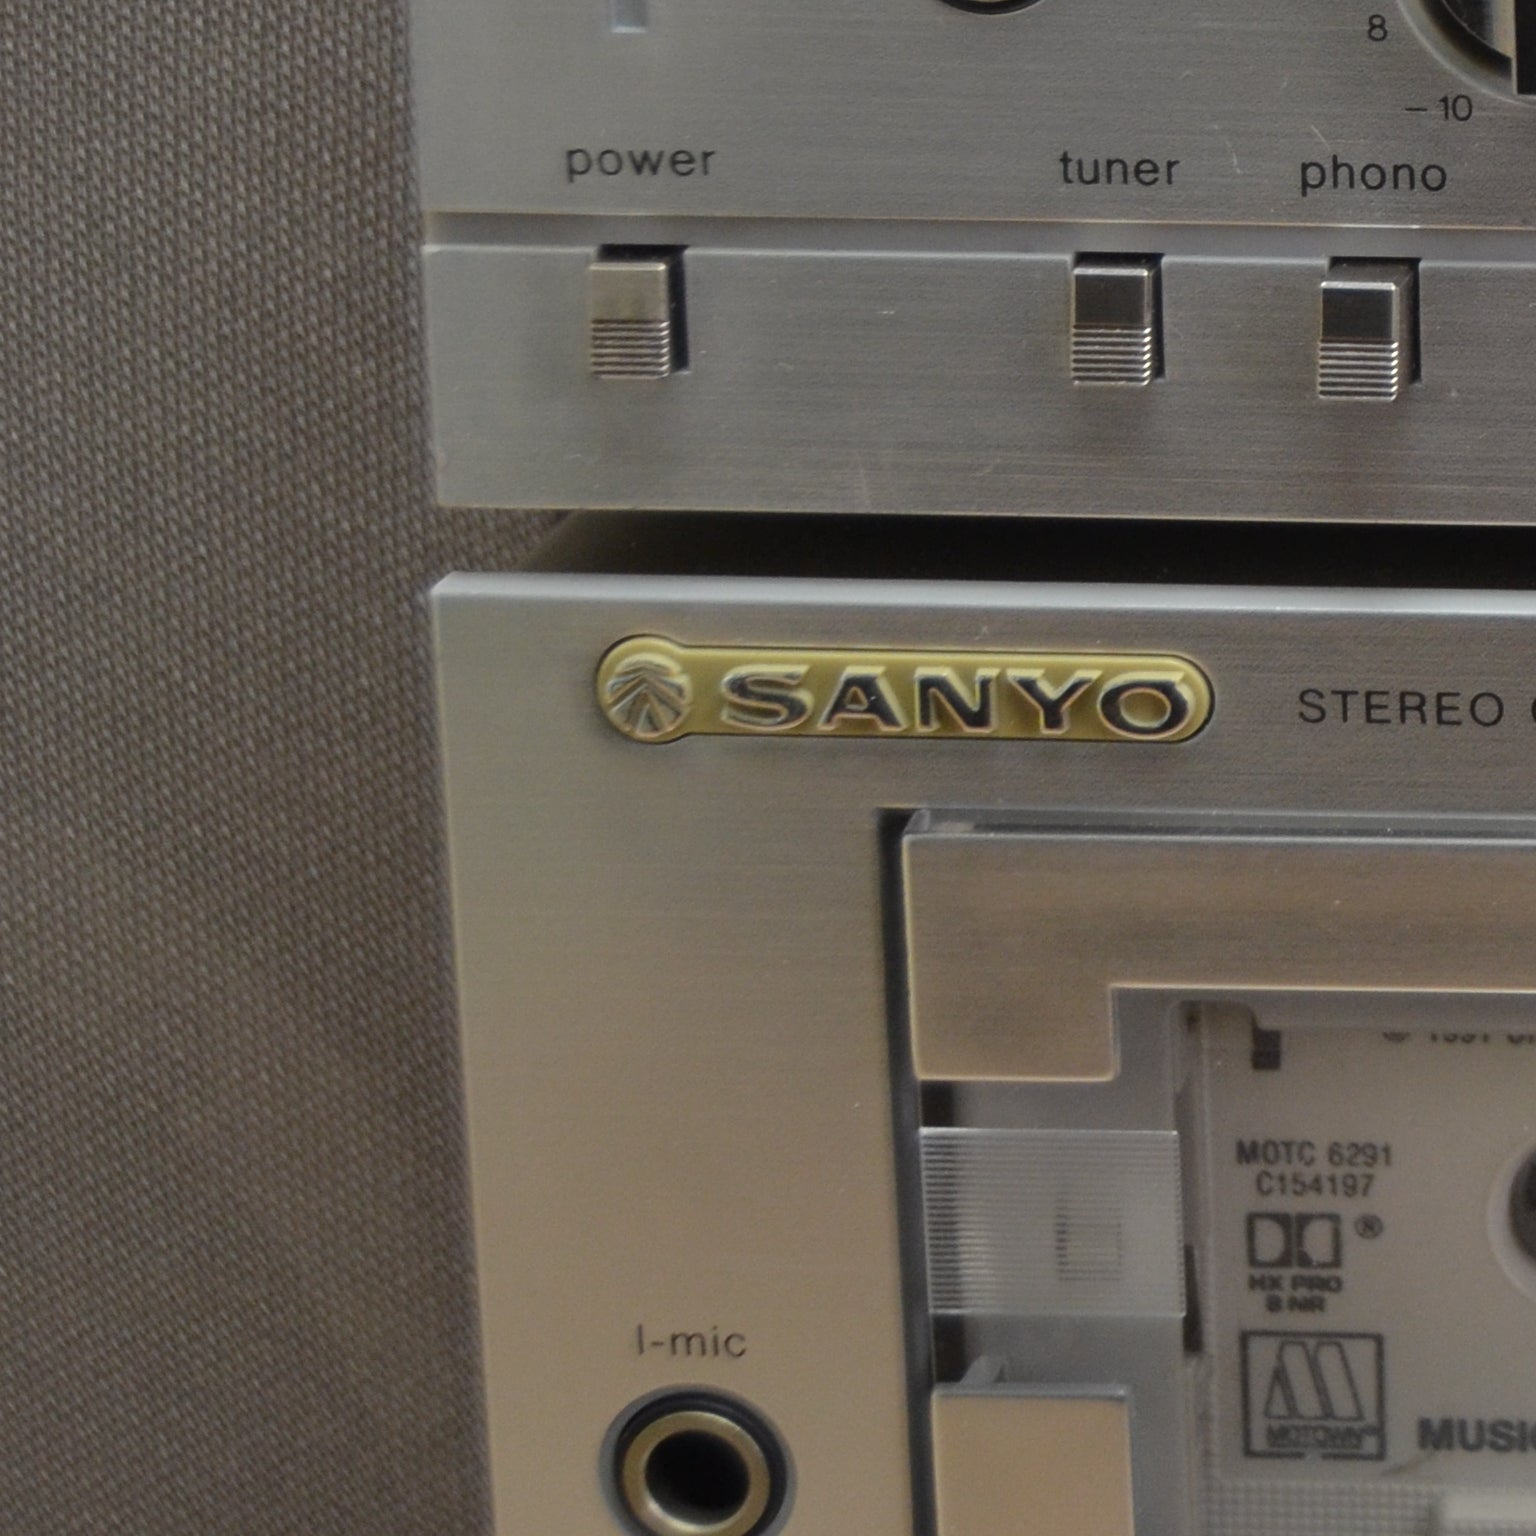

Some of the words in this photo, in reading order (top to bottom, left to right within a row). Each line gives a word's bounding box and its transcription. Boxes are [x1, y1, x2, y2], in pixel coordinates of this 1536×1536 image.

[1366, 13, 1389, 43] 8
[565, 148, 716, 183] power
[1058, 151, 1180, 187] tuner
[1300, 154, 1448, 198] phono
[718, 662, 1194, 740] SANYO
[1298, 688, 1505, 728] STEREO
[1235, 1138, 1318, 1168] MOTC
[1326, 1141, 1393, 1168] 6291
[1255, 1170, 1376, 1199] C154197
